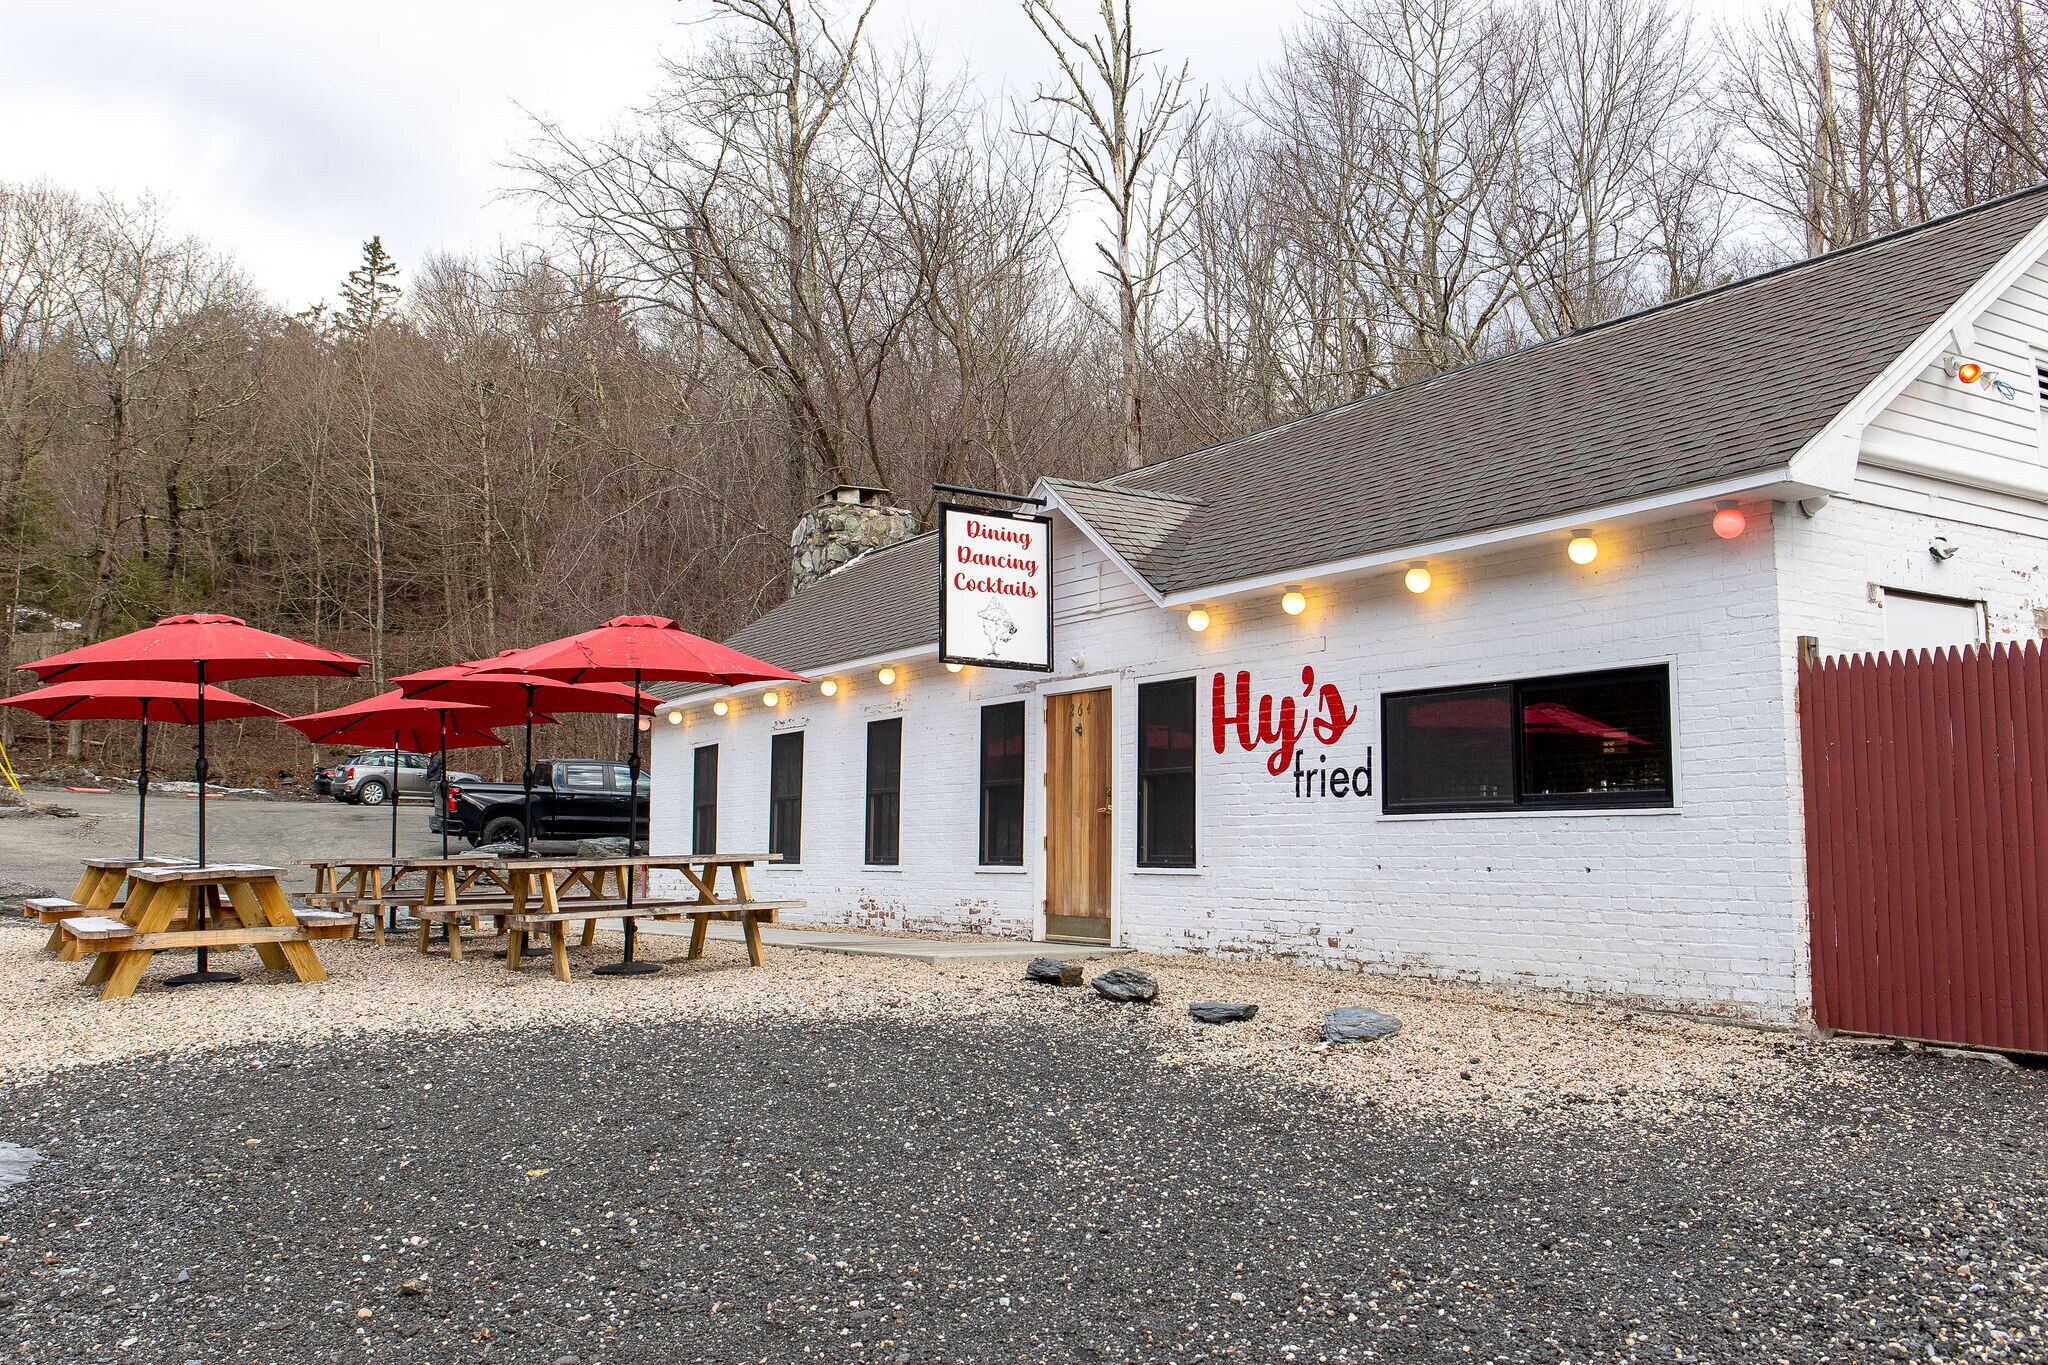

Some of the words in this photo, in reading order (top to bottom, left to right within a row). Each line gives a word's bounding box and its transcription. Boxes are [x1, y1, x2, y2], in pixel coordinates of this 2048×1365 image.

[966, 520, 1033, 550] Dining
[957, 545, 1039, 577] Dancing
[953, 572, 1039, 599] Cocktails
[1212, 665, 1358, 777] Hy's
[1293, 745, 1372, 798] fried
